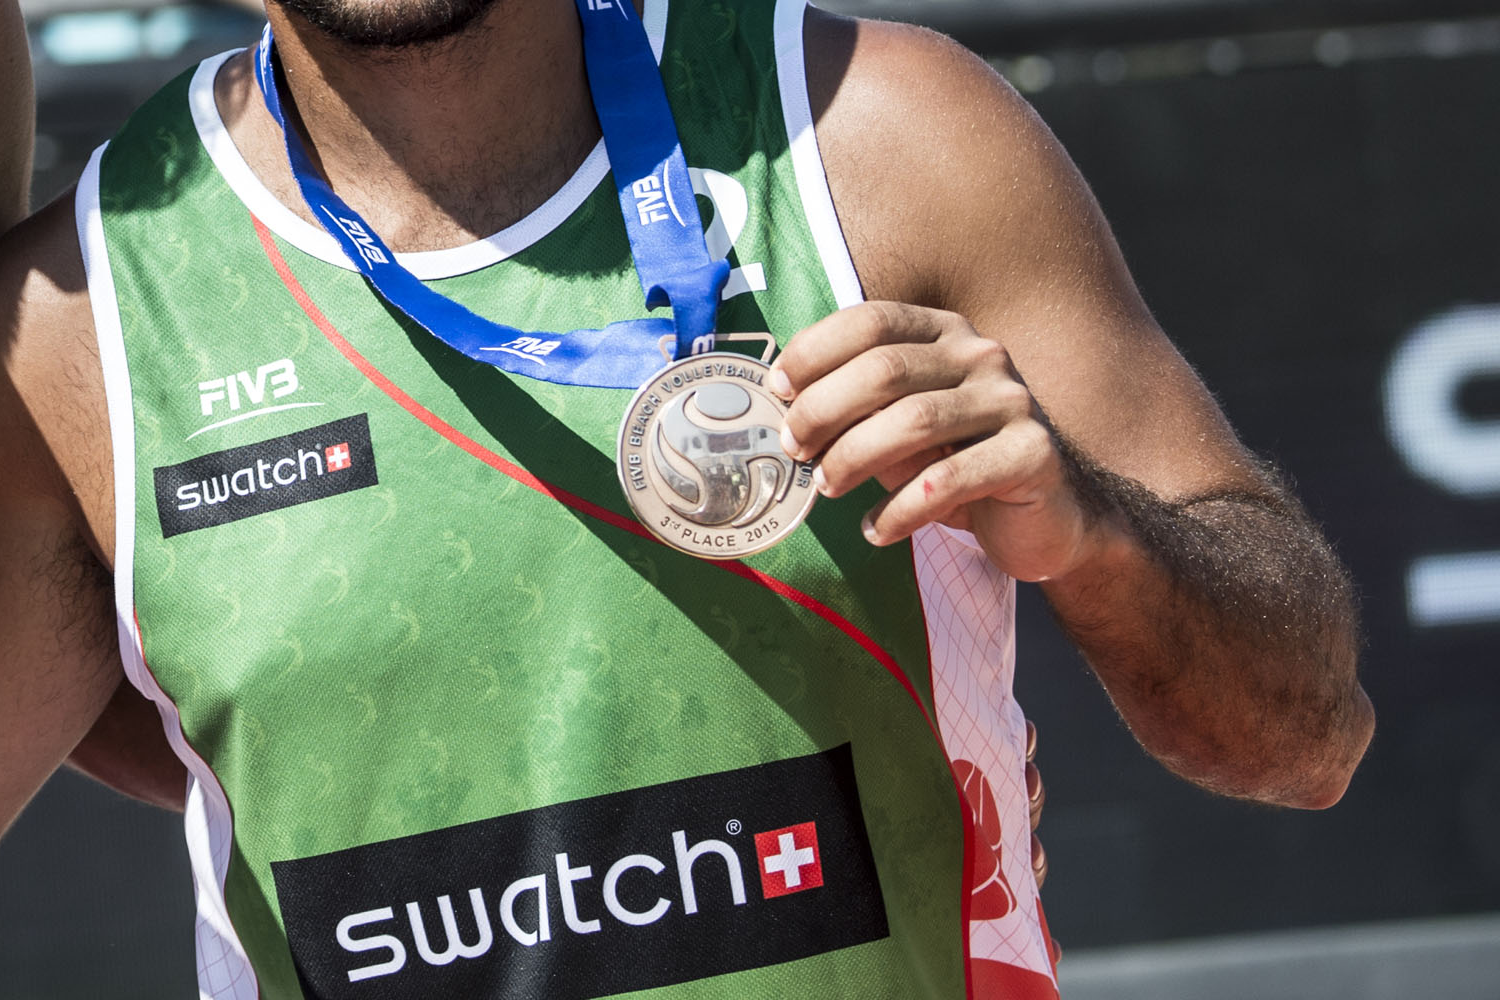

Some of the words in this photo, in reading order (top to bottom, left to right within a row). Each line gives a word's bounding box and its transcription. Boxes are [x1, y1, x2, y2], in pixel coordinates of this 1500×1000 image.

[633, 175, 669, 226] FIVB
[339, 217, 389, 264] FIVB
[501, 336, 561, 356] FIVB
[199, 358, 299, 416] FIVB
[660, 362, 764, 395] VOLLEYBALL
[630, 393, 661, 448] BEACH
[176, 448, 324, 511] swatch
[628, 454, 648, 491] FIVB
[681, 528, 737, 548] PLACE
[745, 517, 780, 544] 2015
[336, 829, 748, 983] swatch
